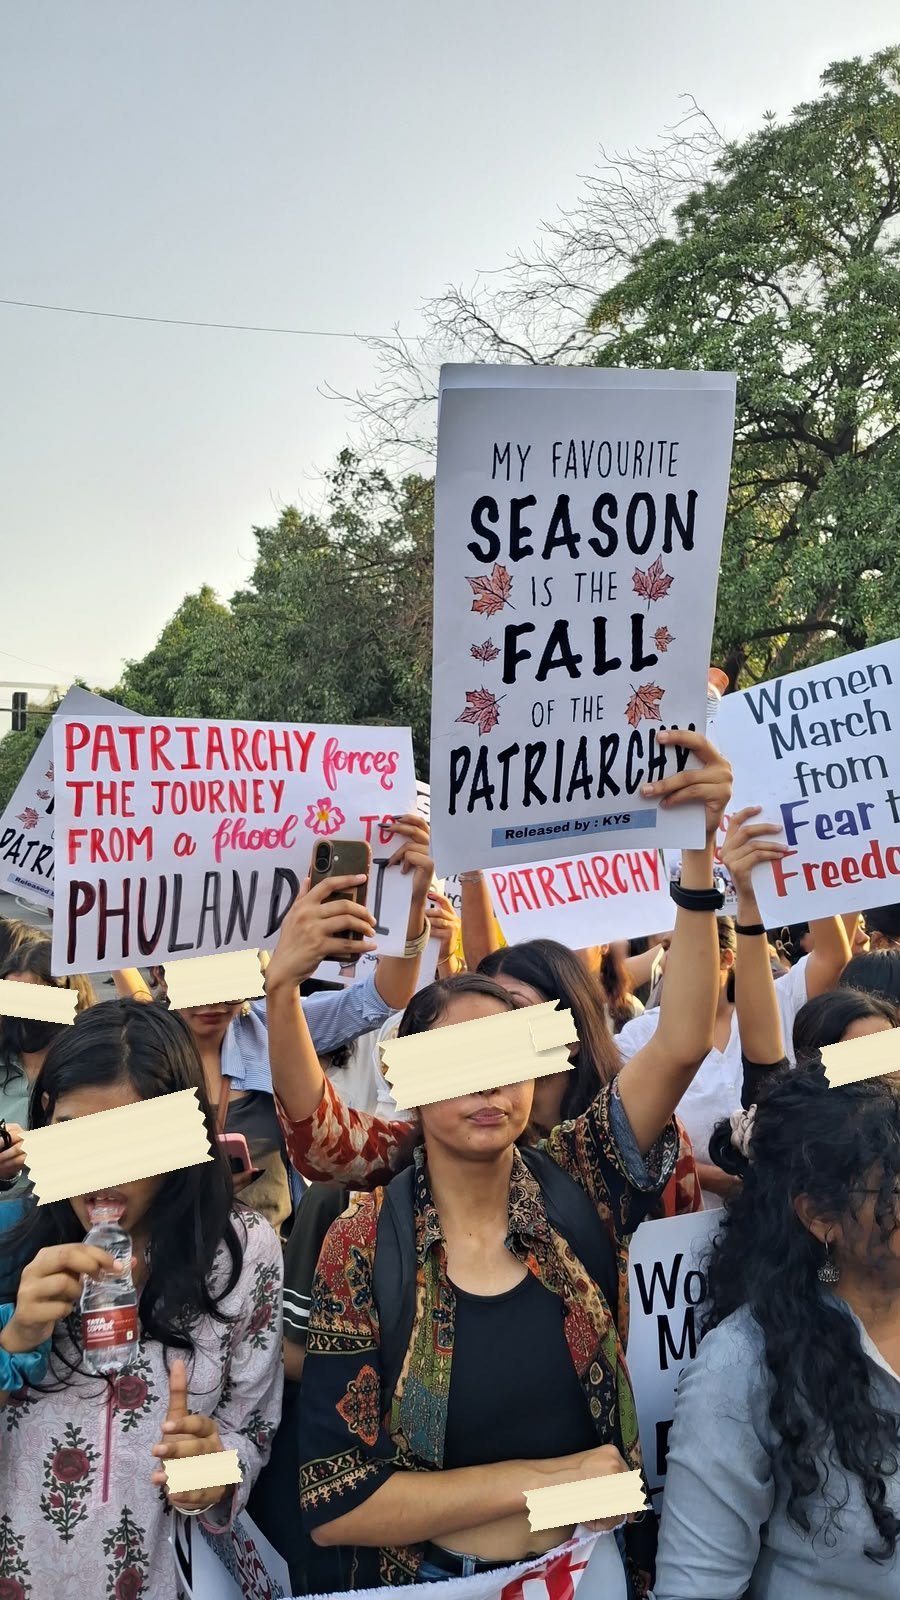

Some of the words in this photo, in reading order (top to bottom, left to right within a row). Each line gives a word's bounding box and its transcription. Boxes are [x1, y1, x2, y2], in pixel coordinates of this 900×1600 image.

[491, 442, 531, 482] MY
[552, 439, 679, 479] FAVOURITE
[467, 489, 698, 563] SEASON
[531, 576, 553, 606] IS
[574, 571, 617, 603] THE
[502, 613, 658, 684] FALL
[531, 699, 555, 728] OF
[570, 695, 604, 723] THE
[743, 663, 893, 725] Women
[65, 722, 316, 773] PATRIARCHY
[322, 737, 400, 791] forces
[768, 699, 892, 760] March
[448, 722, 696, 815] PATRIARCHY
[794, 754, 888, 798] from
[66, 781, 135, 818] THE
[151, 780, 285, 817] JOURNEY
[505, 822, 570, 840] Released
[574, 819, 590, 832] by
[602, 813, 631, 826] KYS
[780, 800, 875, 846] Fear
[885, 789, 900, 824] t
[0, 827, 54, 881] PATRI
[68, 826, 153, 865] FROM
[174, 835, 196, 856] a
[213, 814, 299, 864] phool
[359, 815, 397, 844] TO
[770, 839, 900, 898] Freedo
[15, 876, 50, 895] Released
[491, 848, 660, 916] PATRIARCHY
[633, 1253, 707, 1315] Wo
[656, 1306, 697, 1371] M
